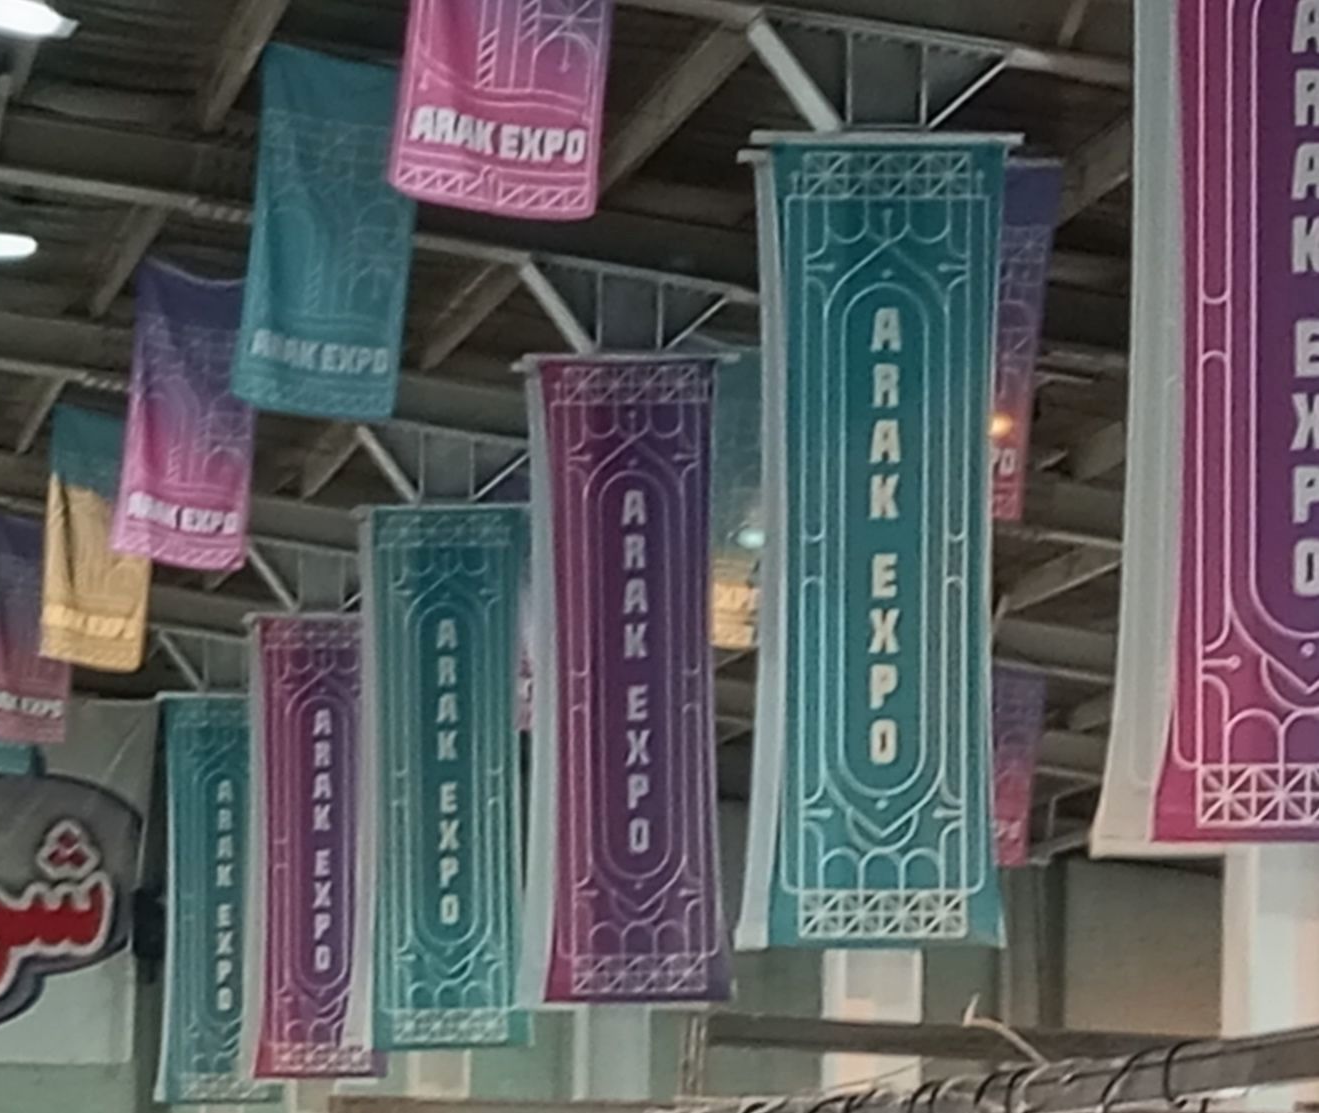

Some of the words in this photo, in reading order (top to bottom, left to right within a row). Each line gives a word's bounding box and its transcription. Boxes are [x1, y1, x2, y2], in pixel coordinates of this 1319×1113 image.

[412, 106, 497, 154] ARAK
[498, 124, 586, 164] EXPO
[1290, 0, 1319, 273] ARAK
[252, 329, 319, 371] ARAK
[321, 343, 390, 374] EXPO
[870, 306, 901, 522] ARAK
[181, 506, 239, 534] EXPO
[1290, 320, 1319, 598] EXPO
[621, 489, 647, 659] ARAK
[436, 617, 458, 762] ARAK
[868, 553, 899, 766] EXPO
[216, 780, 234, 887] ARAK
[312, 708, 333, 831] ARAK
[626, 684, 650, 854] EXPO
[313, 849, 332, 973] EXPO
[439, 781, 460, 925] EXPO
[217, 904, 233, 1011] EXPO
